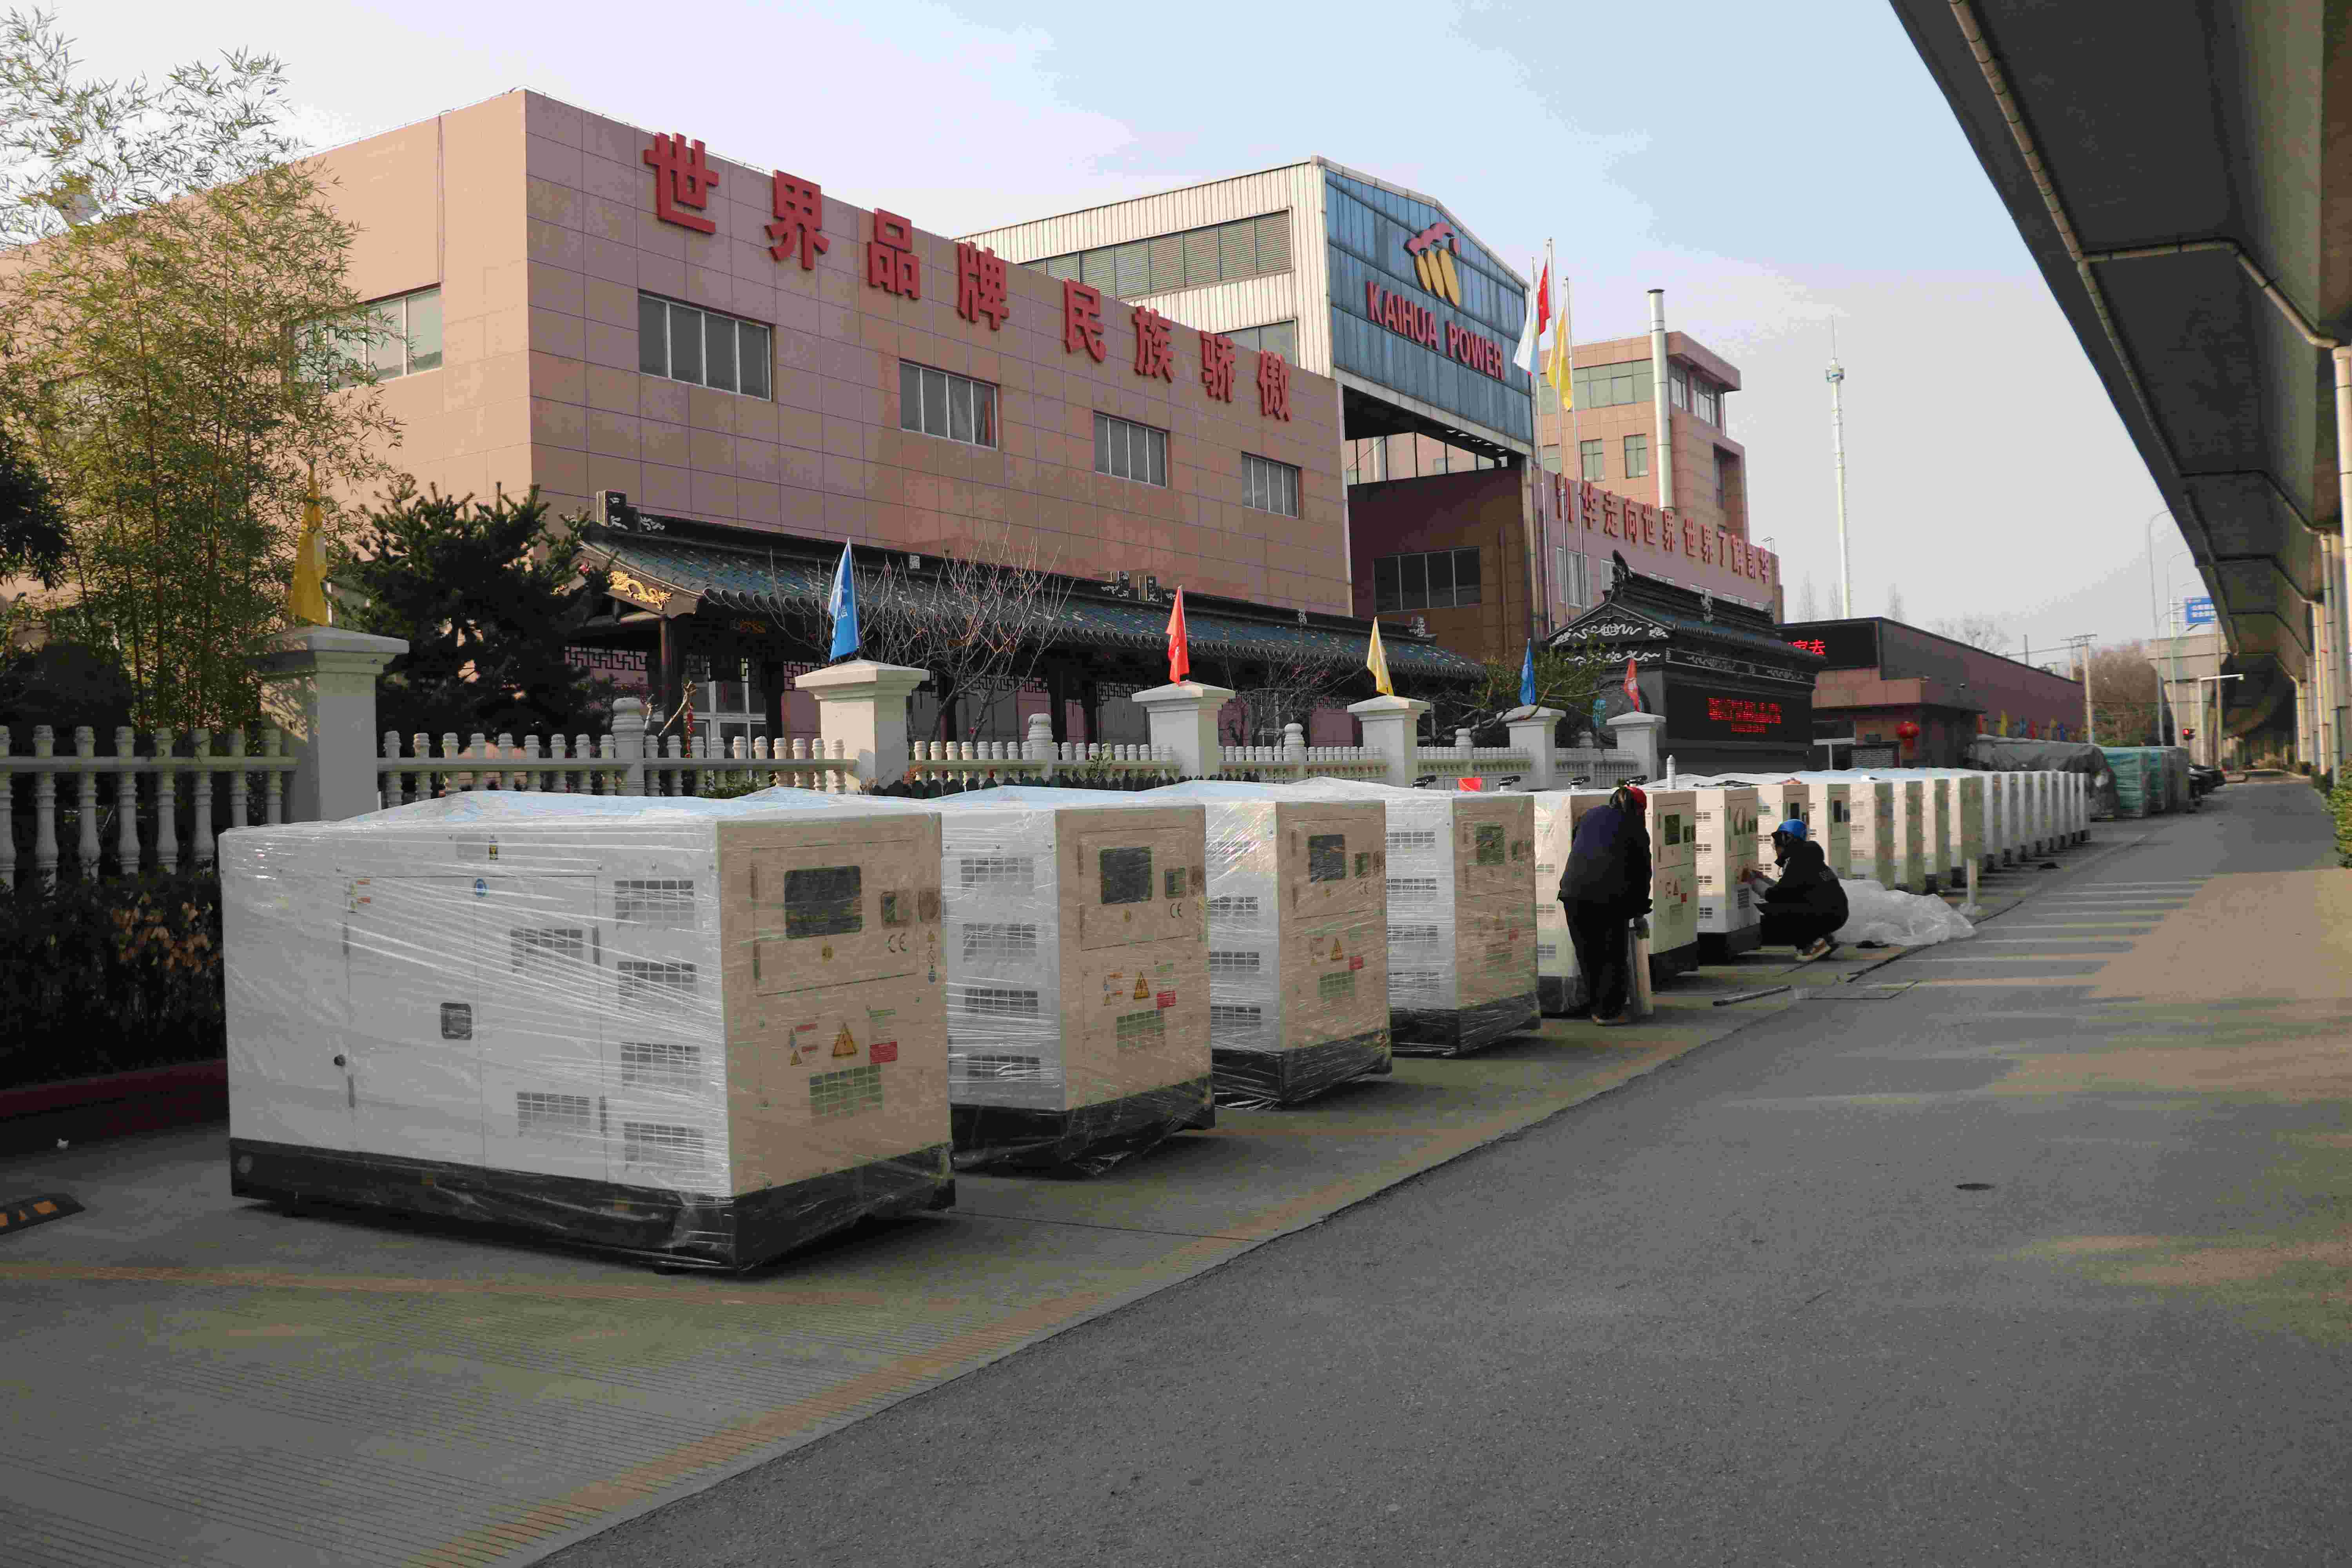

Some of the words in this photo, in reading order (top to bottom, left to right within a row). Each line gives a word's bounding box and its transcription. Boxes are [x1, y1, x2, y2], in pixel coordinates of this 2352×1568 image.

[644, 132, 1010, 330] 世界品牌
[1063, 278, 1292, 422] 民族骄傲
[1366, 281, 1439, 351] KAIHUA
[1445, 320, 1506, 382] POWER
